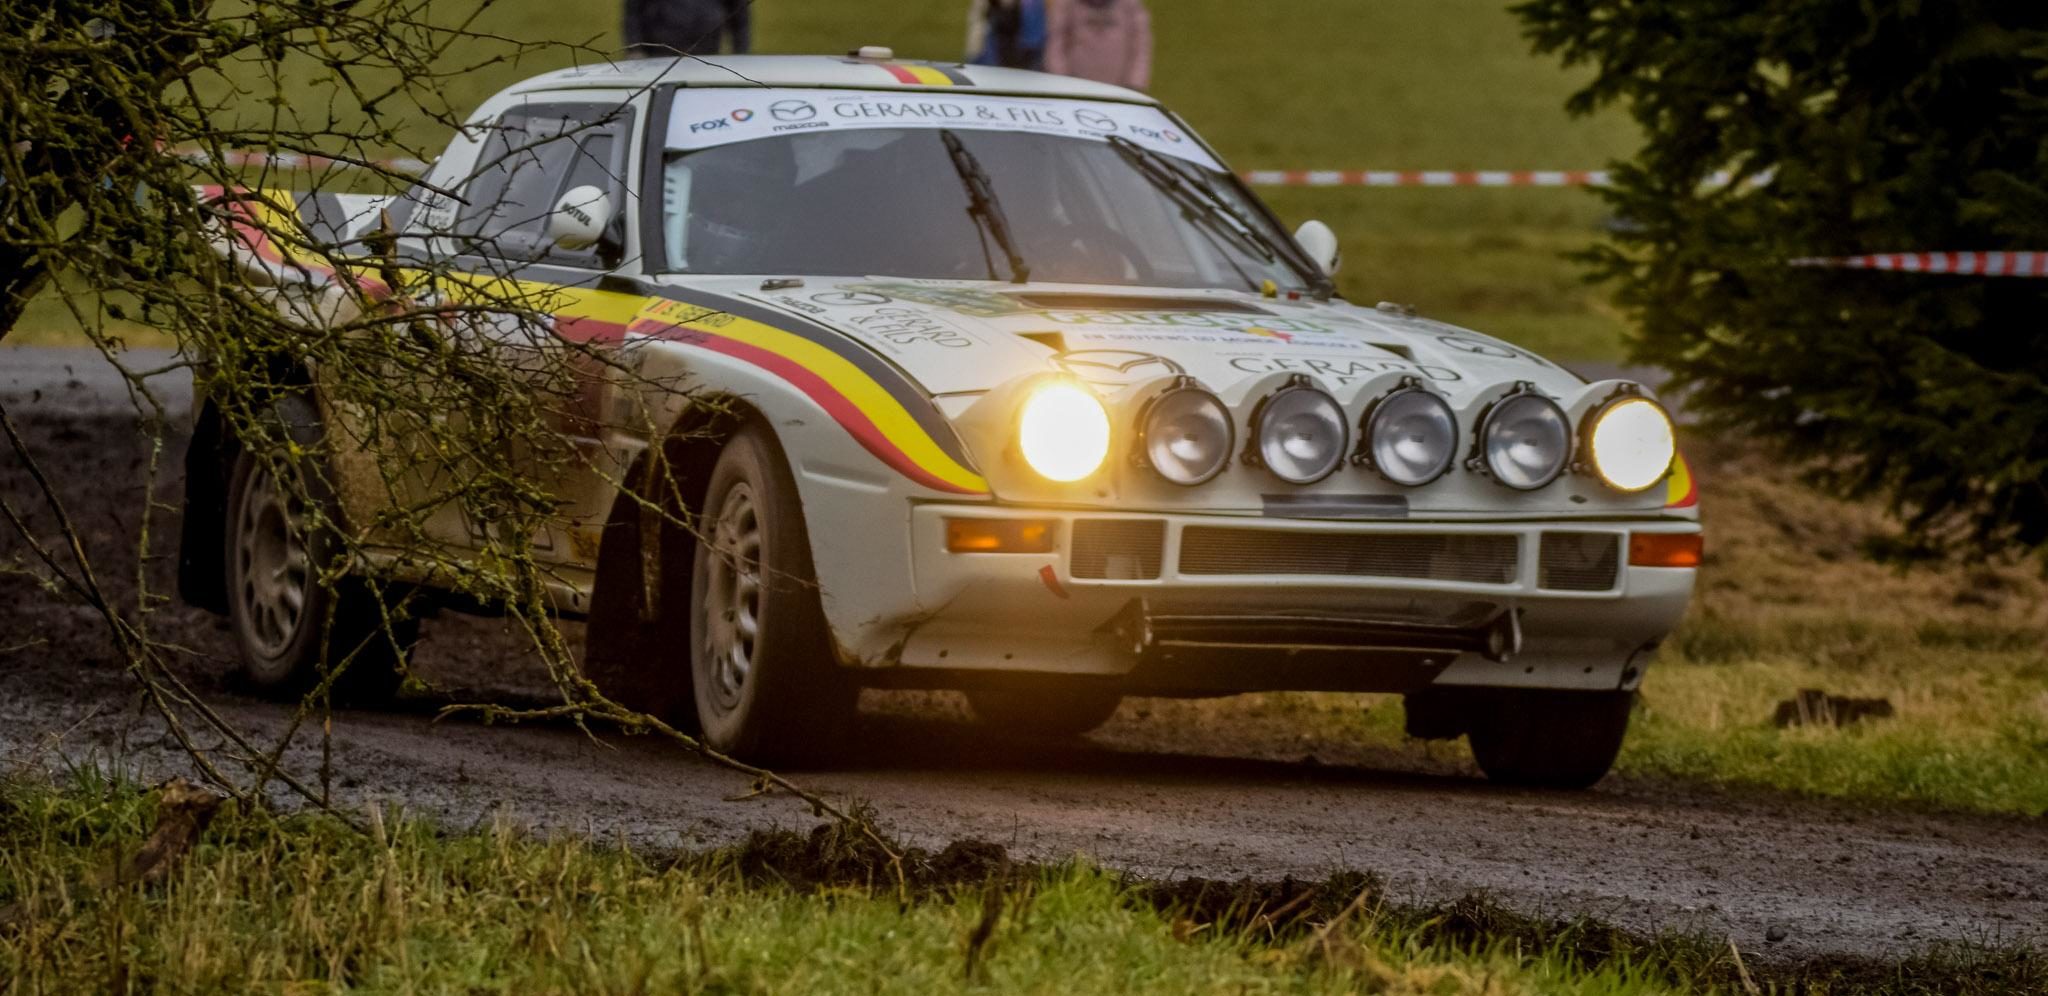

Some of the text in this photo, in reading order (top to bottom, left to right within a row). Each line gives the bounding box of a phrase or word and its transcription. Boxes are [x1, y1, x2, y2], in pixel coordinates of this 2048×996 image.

[833, 102, 1064, 125] GERARD & FILS
[689, 117, 731, 134] FOX
[772, 121, 830, 132] mazda
[1128, 124, 1161, 139] FOX
[560, 202, 592, 227] MOTUL
[868, 323, 929, 344] FILS
[874, 307, 973, 348] GERARD
